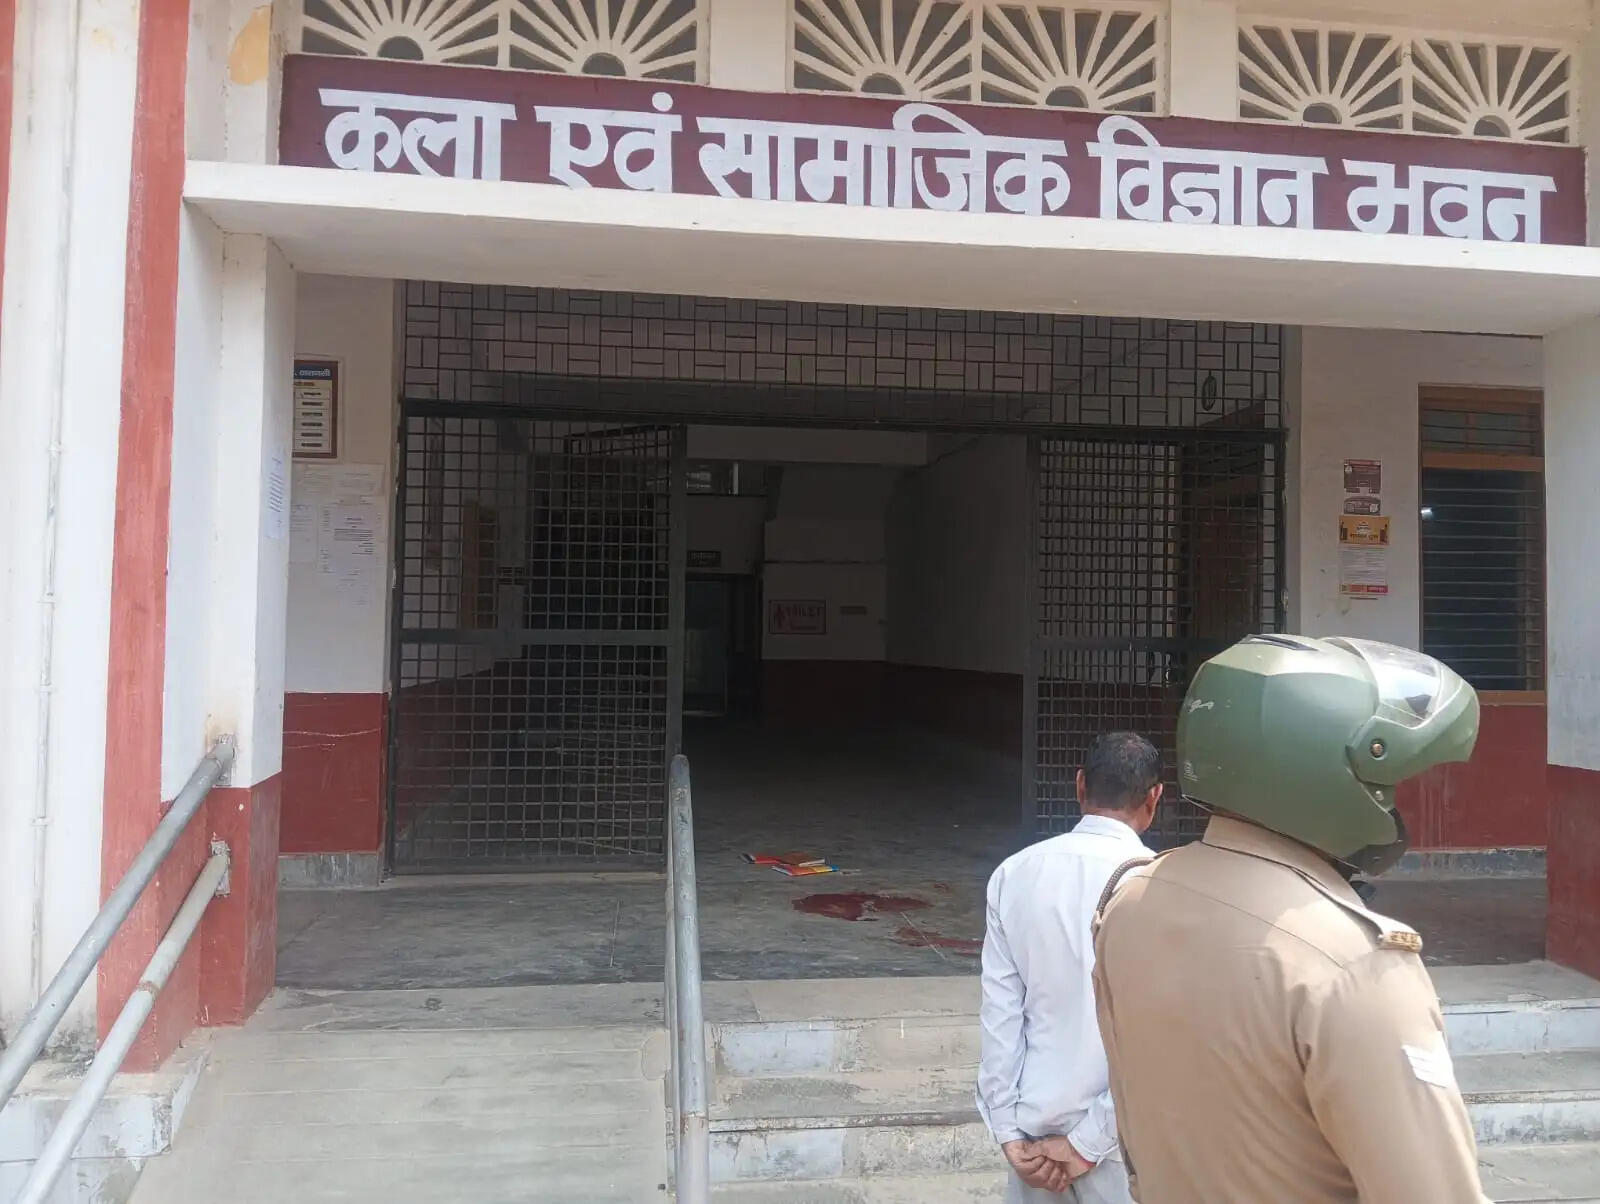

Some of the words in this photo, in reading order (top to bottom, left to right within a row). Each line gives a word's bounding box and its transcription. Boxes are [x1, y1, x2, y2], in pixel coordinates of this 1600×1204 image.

[318, 88, 516, 181] कला
[534, 92, 682, 193] एवं
[697, 101, 1072, 217] सामाजिक
[1087, 114, 1328, 230] विज्ञान
[1342, 158, 1557, 244] भवन
